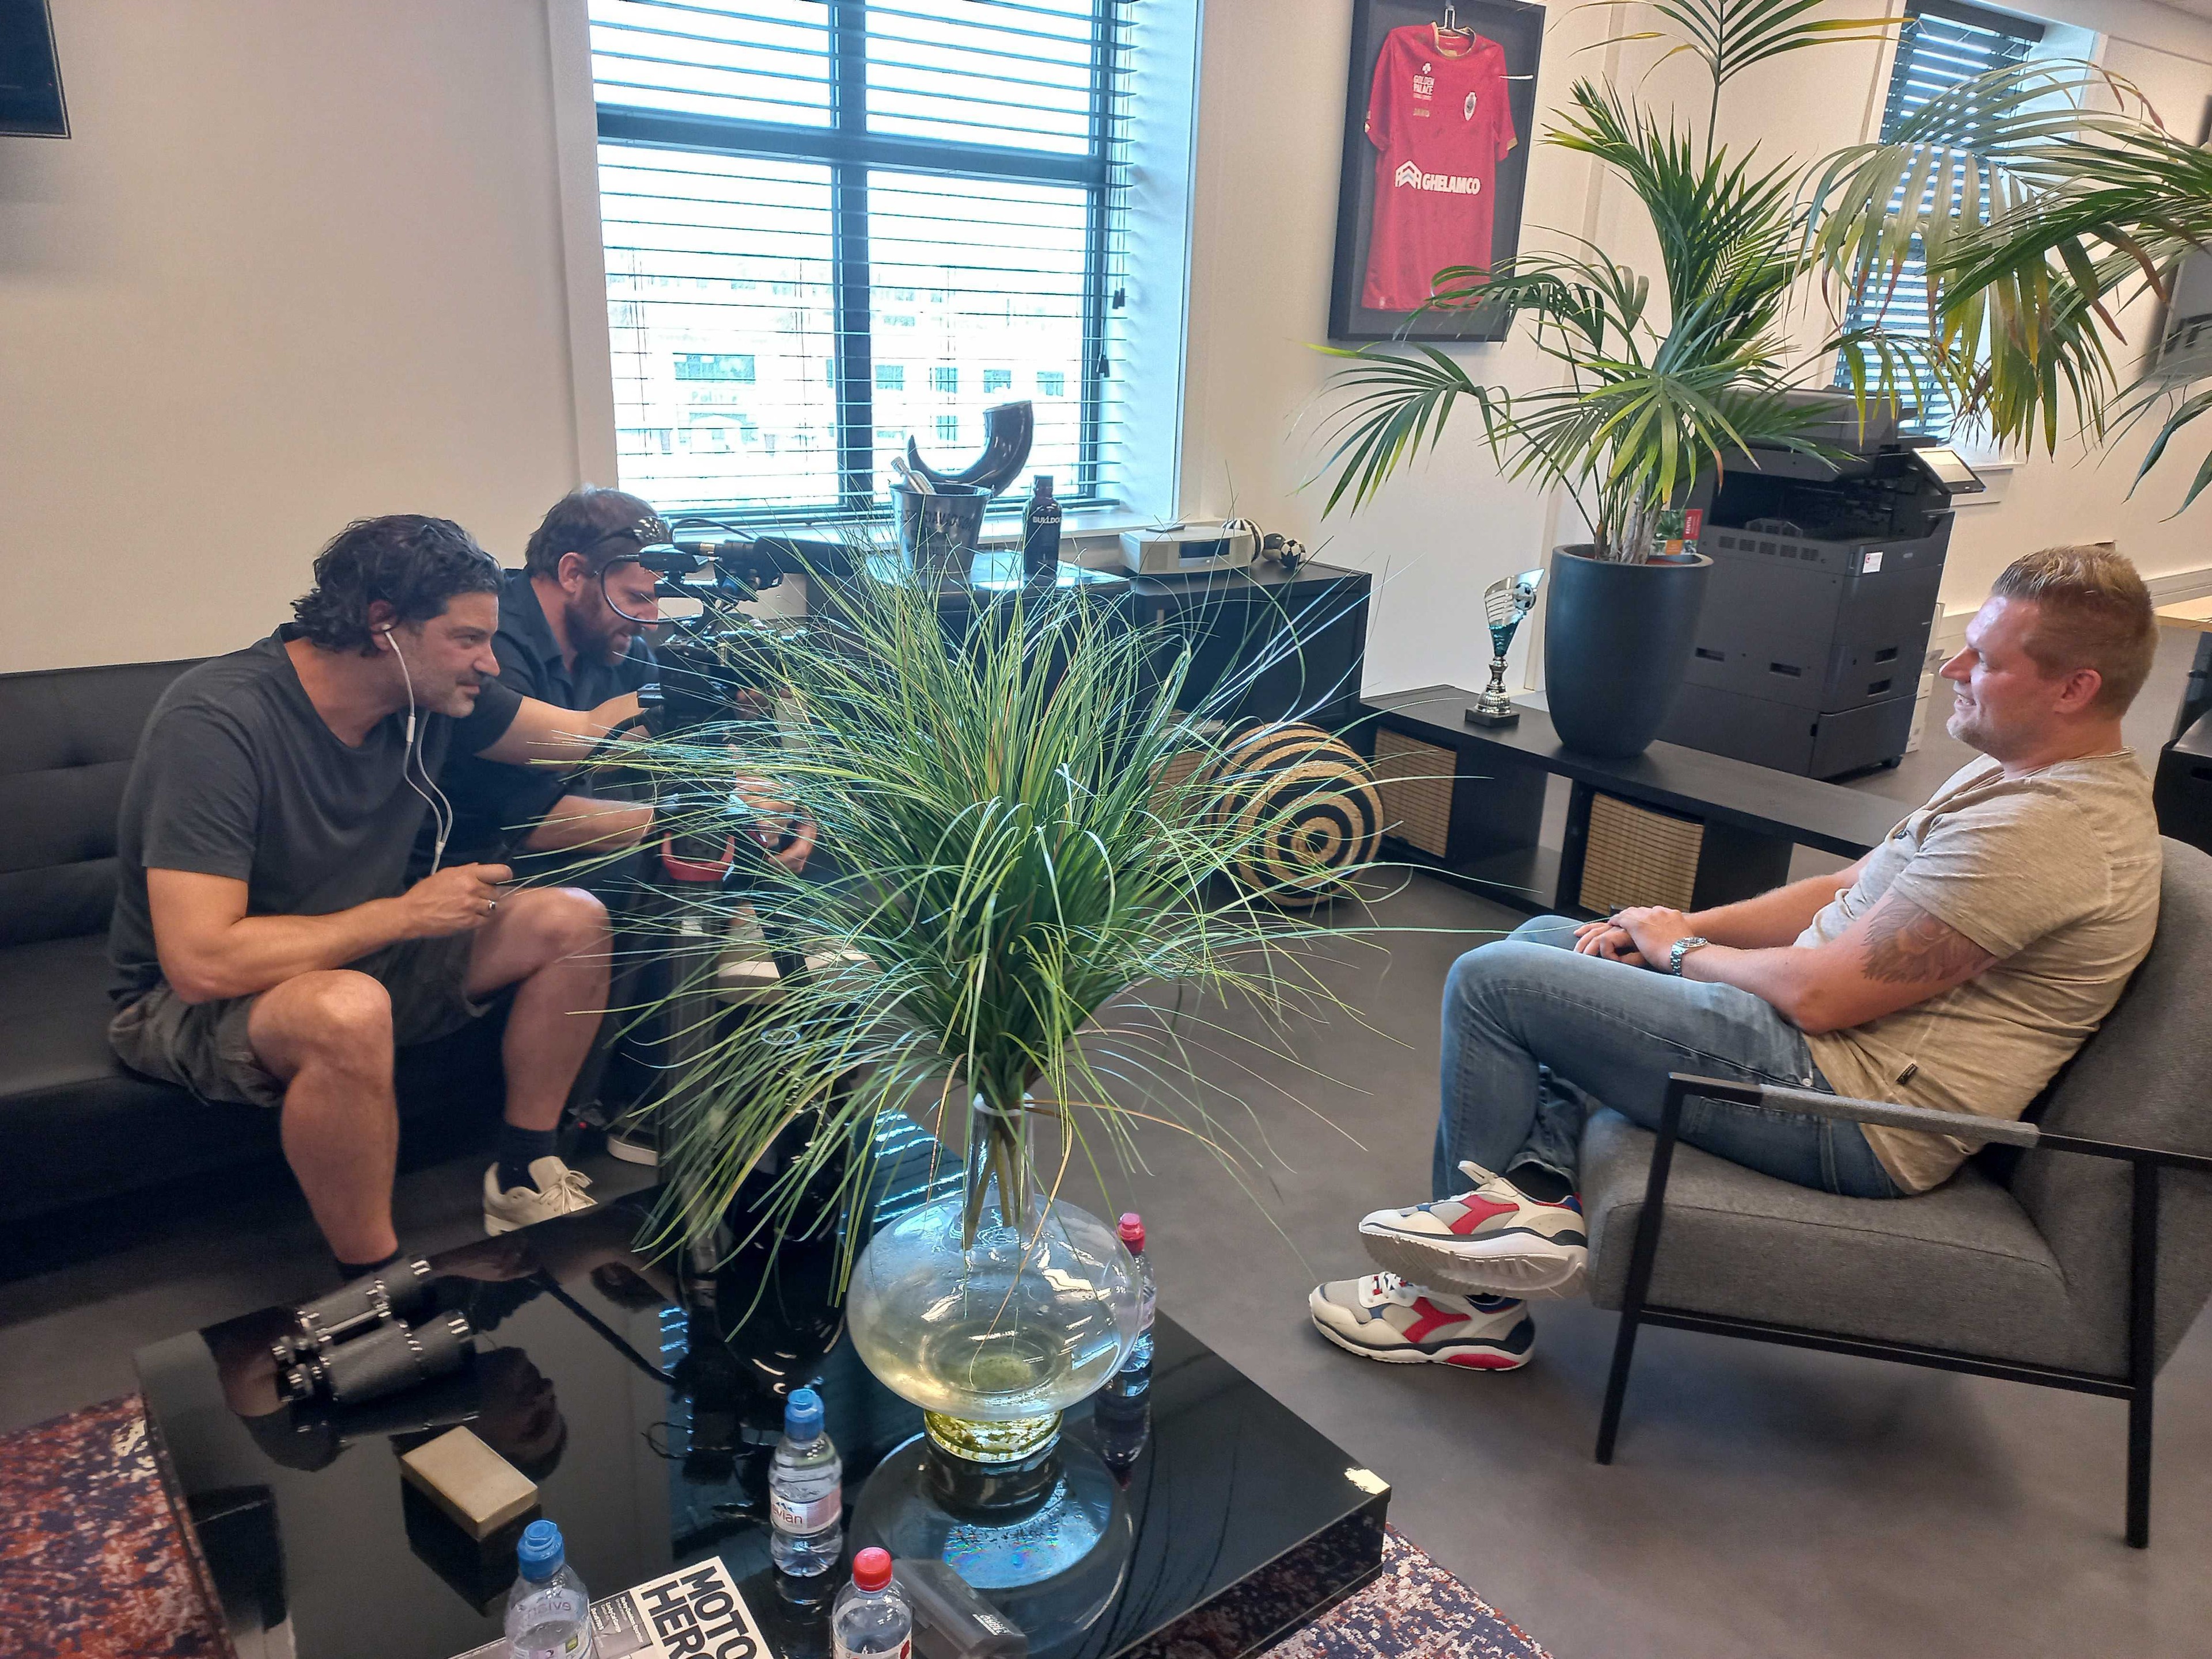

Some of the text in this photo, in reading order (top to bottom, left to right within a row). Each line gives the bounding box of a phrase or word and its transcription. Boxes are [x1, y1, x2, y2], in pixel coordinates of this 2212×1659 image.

[1413, 75, 1435, 85] GOLDEN
[1413, 83, 1433, 96] PALACE
[1422, 173, 1481, 195] GHELAMCO
[692, 391, 737, 403] Polite
[772, 1503, 802, 1524] evian
[641, 1580, 714, 1659] HER
[679, 1566, 757, 1659] MOTO
